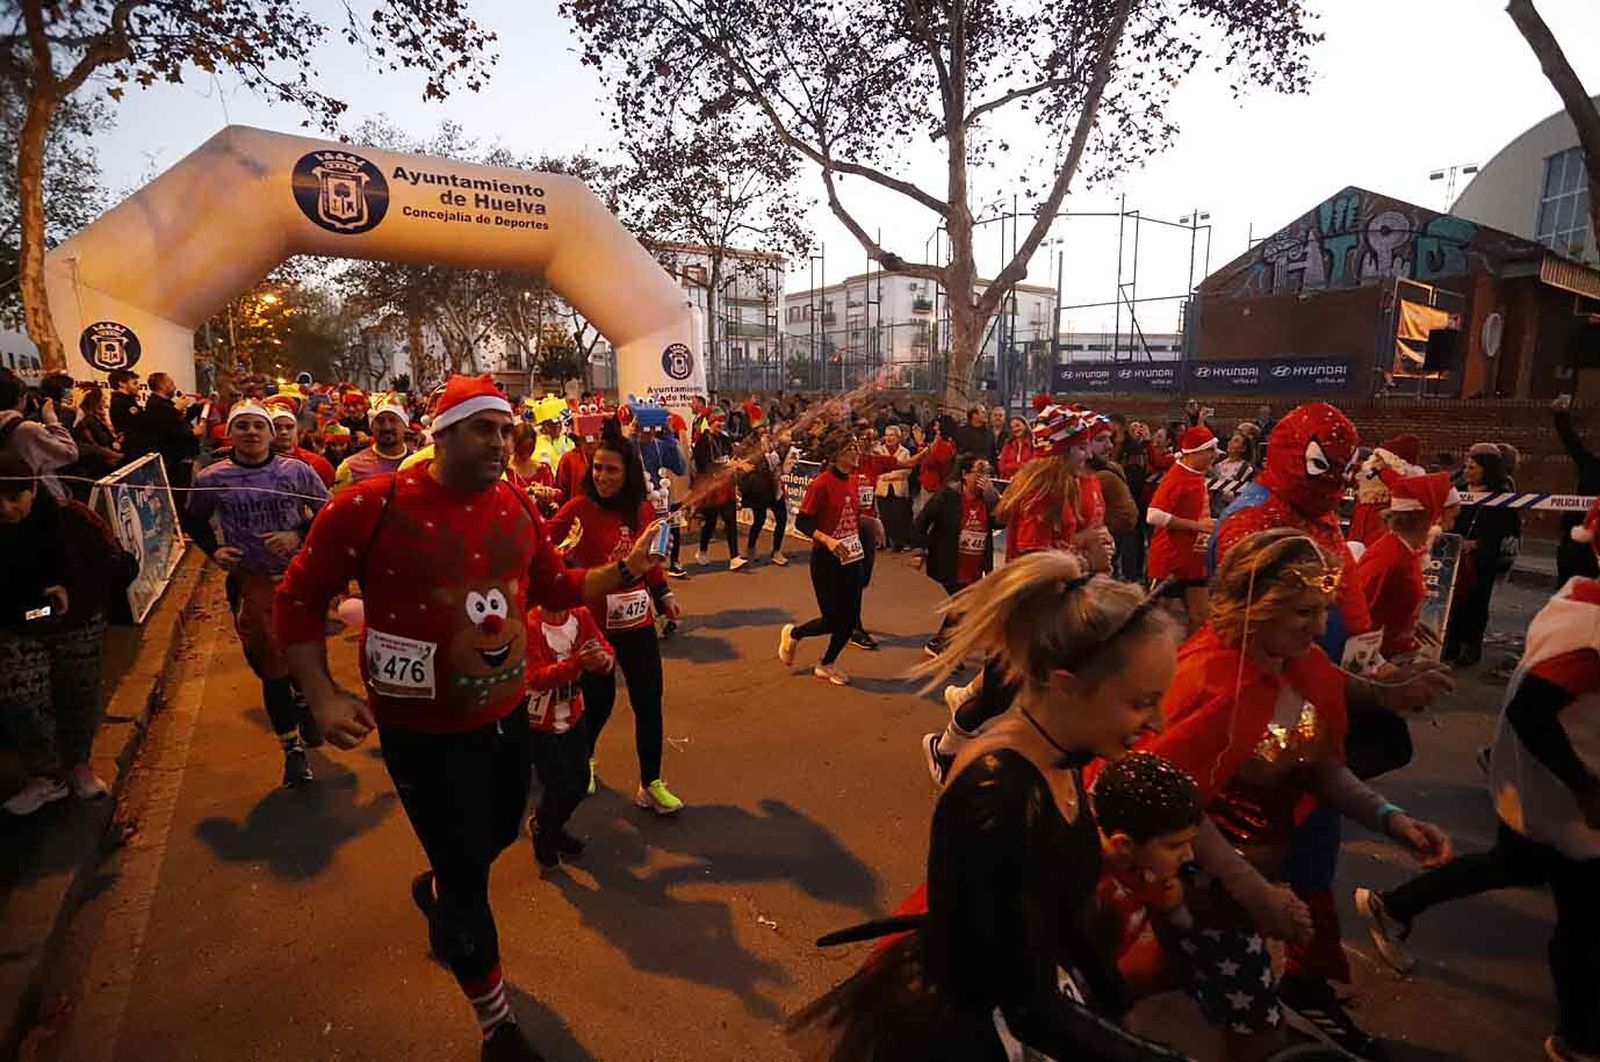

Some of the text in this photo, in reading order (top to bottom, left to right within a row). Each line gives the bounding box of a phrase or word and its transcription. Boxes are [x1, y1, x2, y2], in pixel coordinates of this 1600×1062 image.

[393, 166, 545, 198] Ayuntamiento
[440, 190, 547, 216] de Huelva
[476, 213, 491, 225] de
[495, 215, 549, 231] Deportes
[1075, 371, 1110, 379] HYUNDAI
[1134, 369, 1174, 378] HYUNDAI
[1212, 367, 1259, 376] HYUNDAI
[1293, 365, 1347, 376] HYUNDAI
[626, 600, 646, 617] 475
[383, 654, 425, 683] 476
